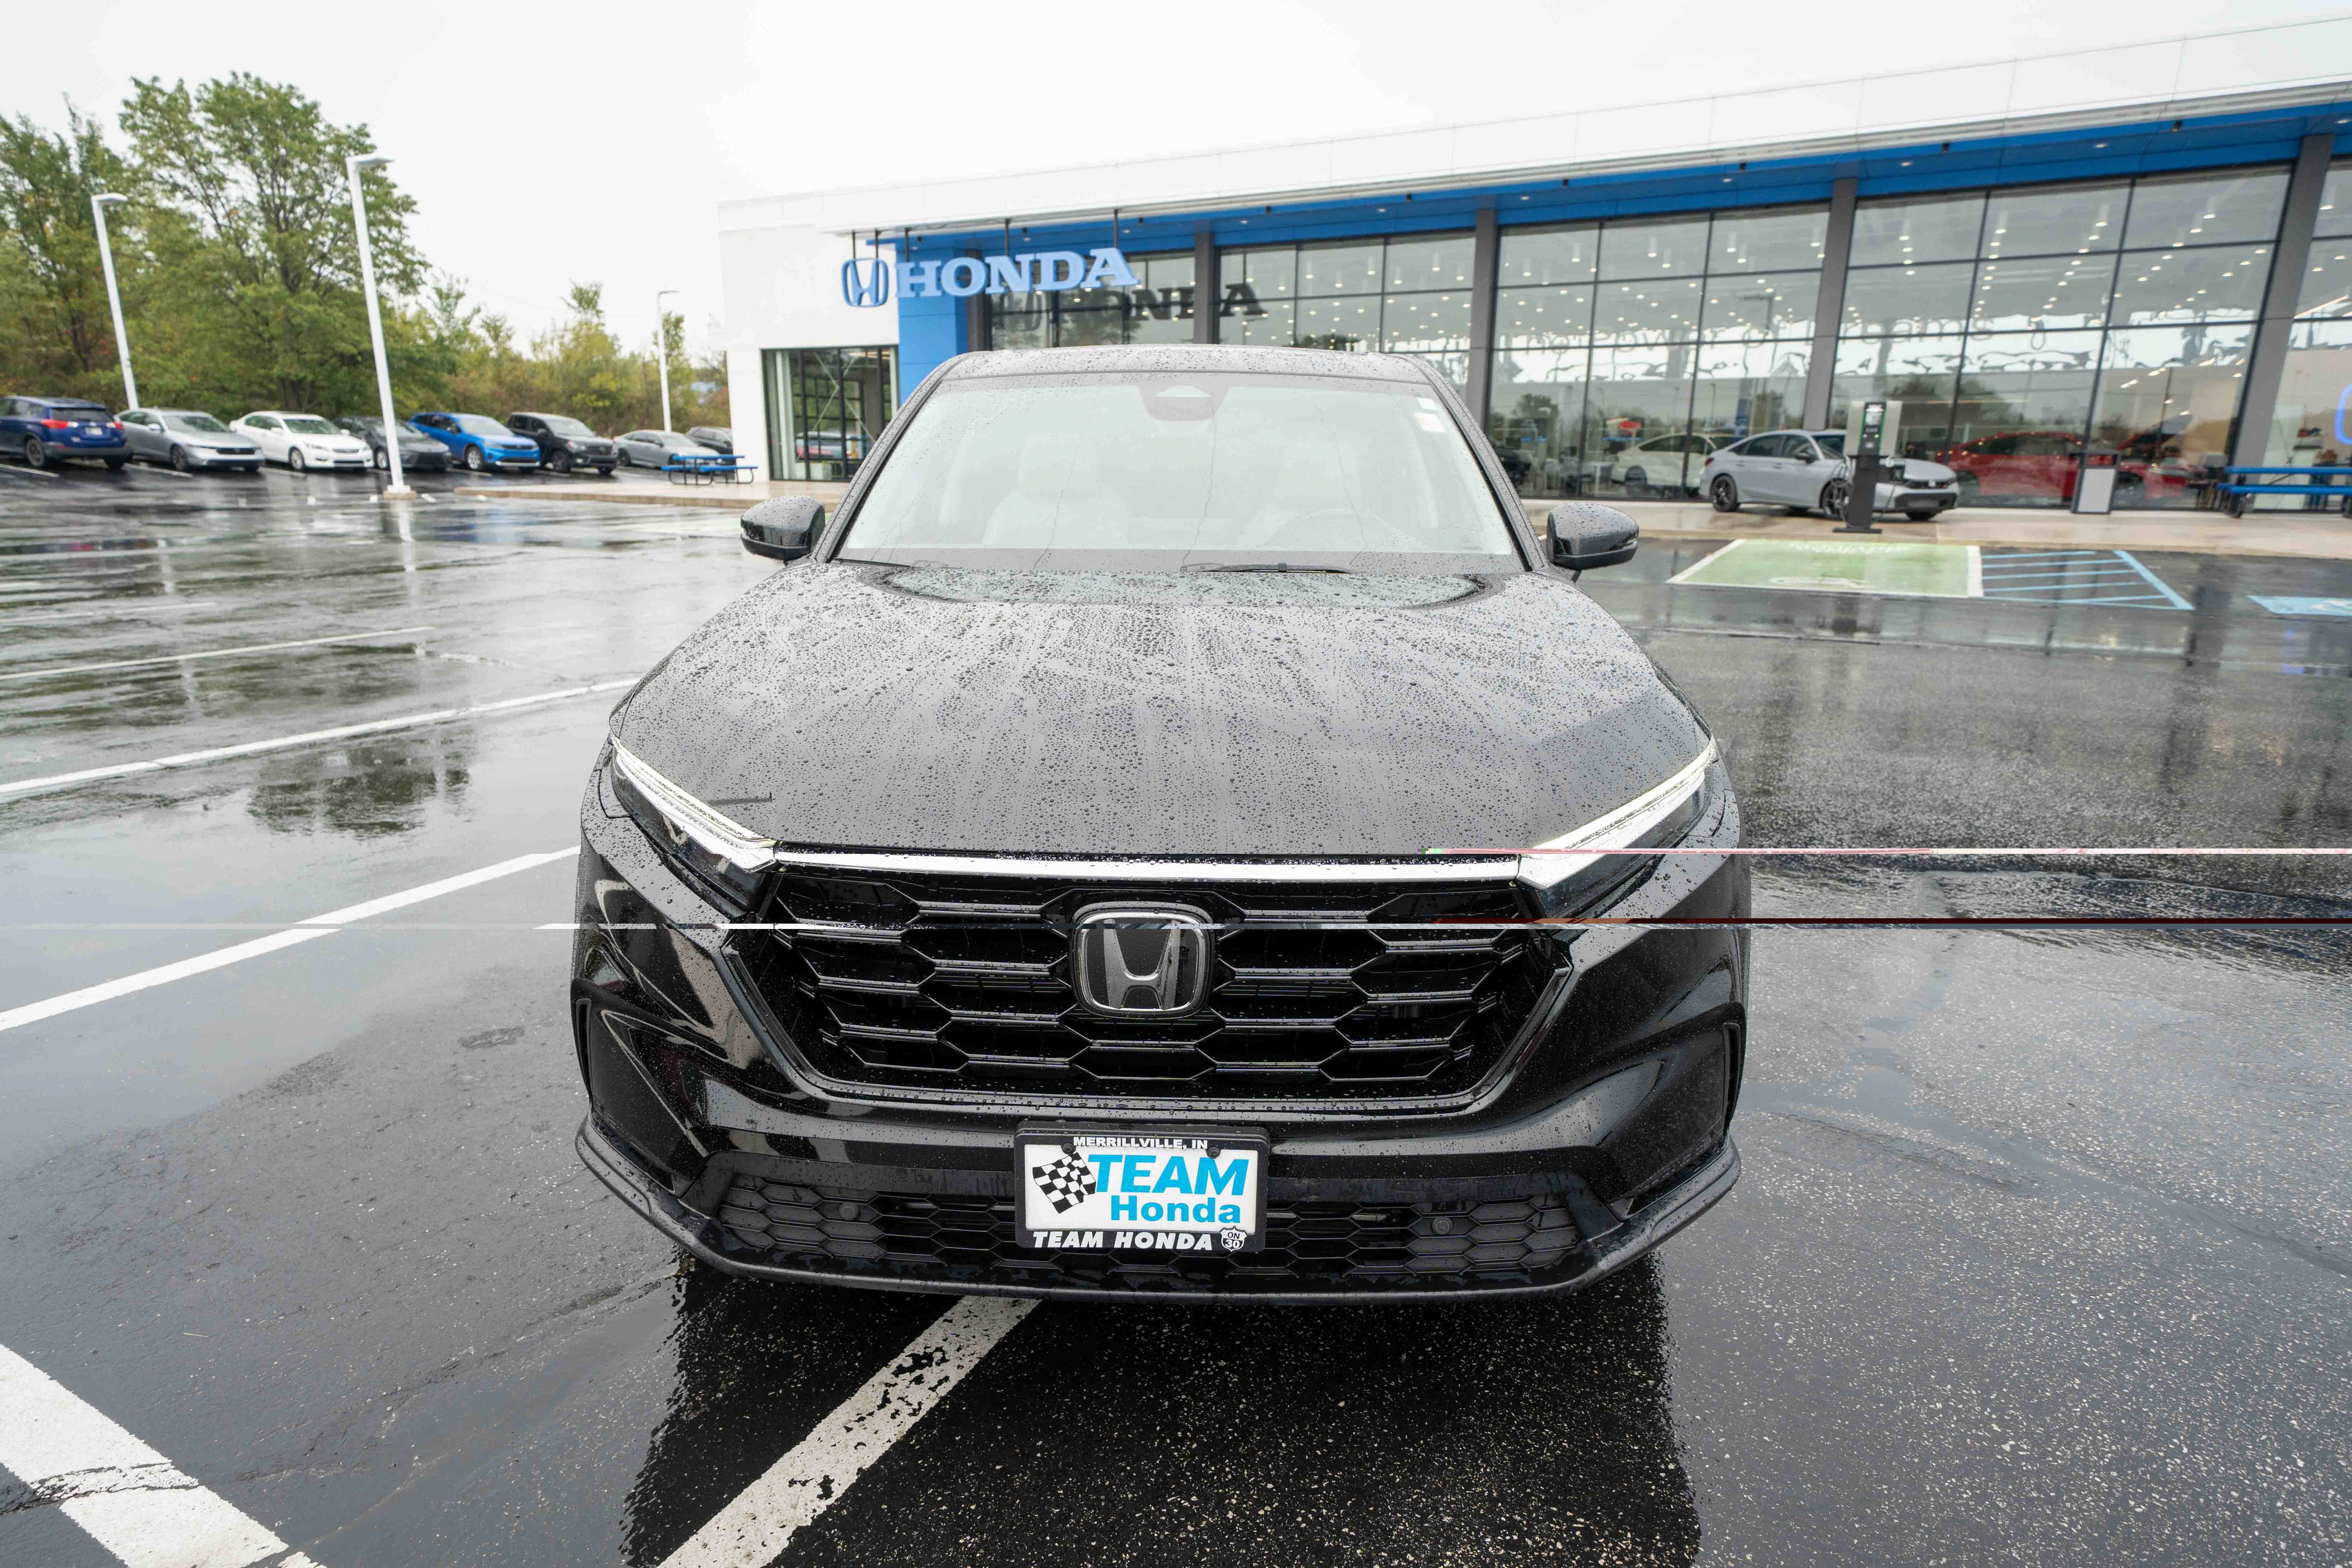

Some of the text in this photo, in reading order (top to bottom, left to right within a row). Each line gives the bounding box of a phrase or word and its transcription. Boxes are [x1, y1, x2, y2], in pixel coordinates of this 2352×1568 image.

[896, 247, 1141, 298] HONDA
[1074, 1137, 1208, 1151] MERRILLVILLE, IN
[1087, 1154, 1250, 1196] TEAM
[1111, 1195, 1241, 1223] Honda
[1033, 1231, 1213, 1251] TEAM HONDA
[1225, 1239, 1240, 1249] 30
